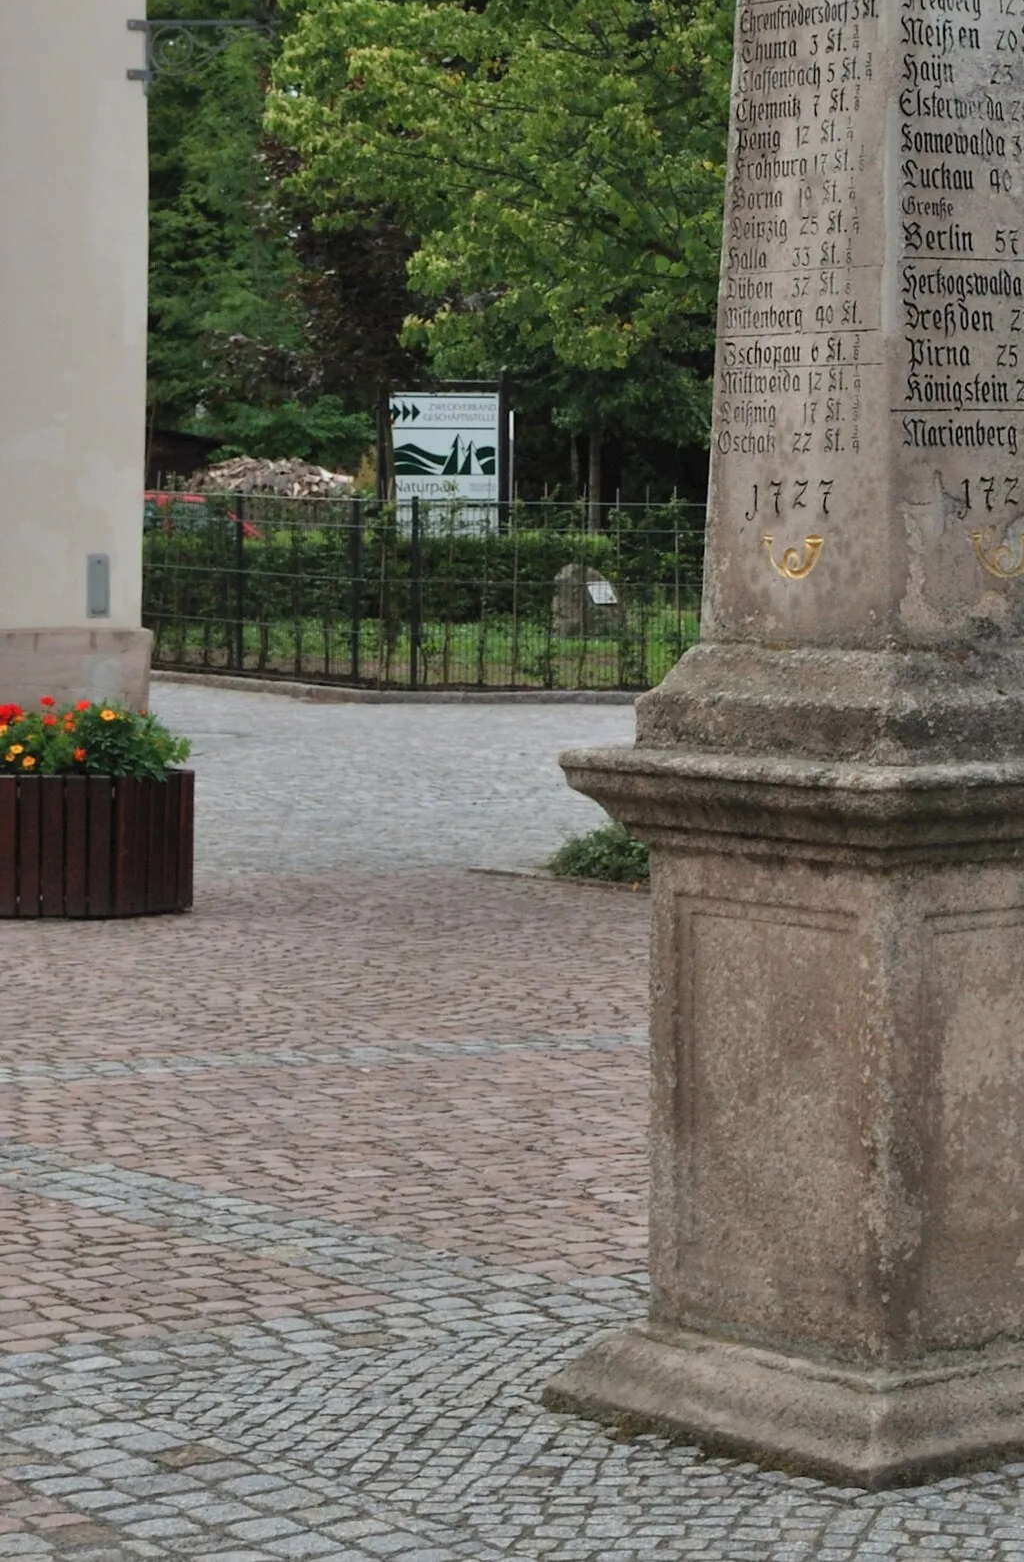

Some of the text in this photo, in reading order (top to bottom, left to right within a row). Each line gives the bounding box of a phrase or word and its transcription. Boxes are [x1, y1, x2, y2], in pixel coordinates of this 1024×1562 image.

[827, 63, 835, 83] 5
[813, 94, 821, 117] 7
[900, 87, 1005, 123] Elsterwerda
[735, 124, 781, 156] Penig
[901, 122, 1006, 158] Sonnewalda
[902, 159, 975, 190] Luckau
[732, 184, 783, 213] Borna
[730, 214, 788, 245] Leipzig
[901, 221, 975, 252] Berlin
[727, 245, 768, 273] Halla
[726, 276, 773, 300] Düben
[723, 339, 801, 370] Zschopau
[811, 342, 819, 362] 6
[905, 336, 971, 372] Pirna
[720, 368, 800, 395] Mittweida
[904, 371, 1009, 412] Königstein
[428, 402, 496, 412] ZWECKVERBAND
[902, 415, 1018, 455] Marienberg
[745, 479, 834, 521] 1727
